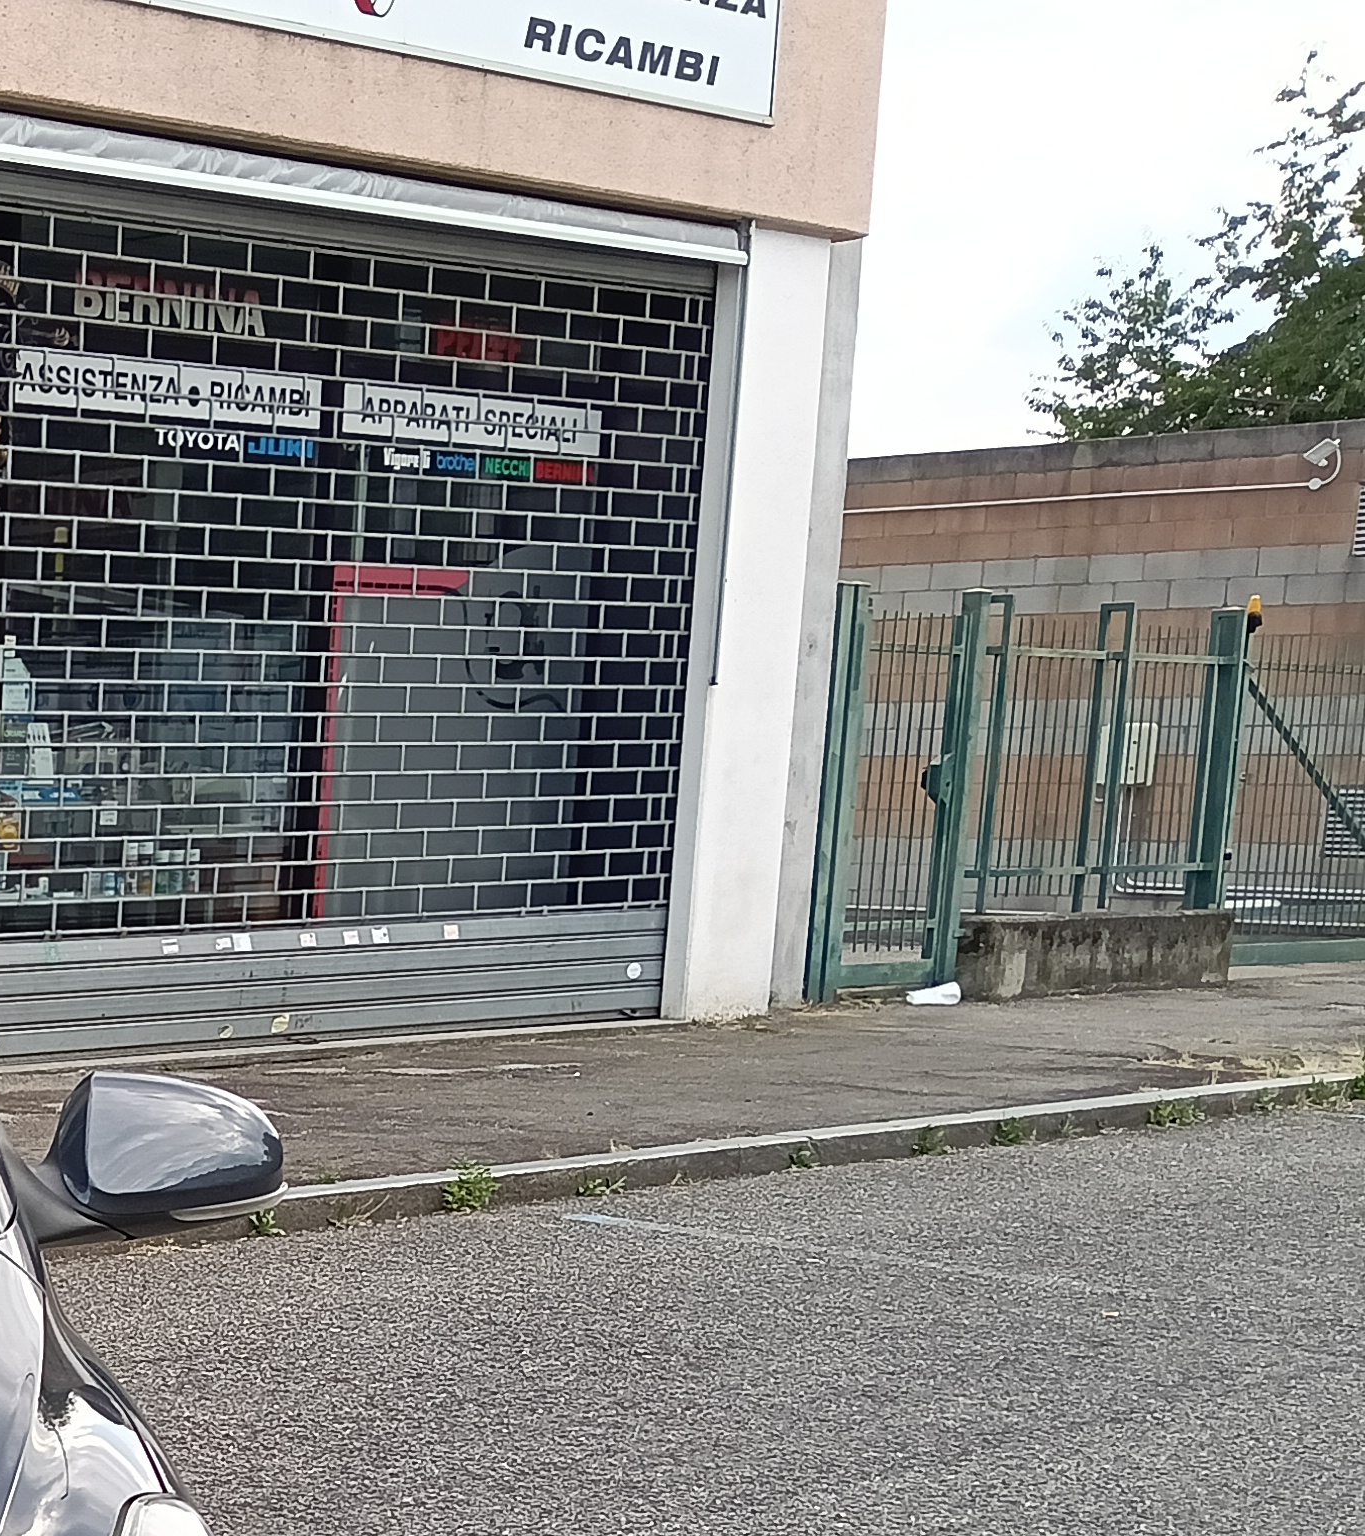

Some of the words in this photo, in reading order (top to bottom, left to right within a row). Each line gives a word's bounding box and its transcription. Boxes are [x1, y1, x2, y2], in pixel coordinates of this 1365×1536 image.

[524, 16, 720, 86] RICAMBI
[73, 268, 266, 337] BERNINA
[19, 361, 181, 405] ASSISTENZA
[210, 380, 311, 418] RICAMBI
[360, 396, 471, 434] APPARATI
[483, 408, 578, 444] SPECIALI
[154, 428, 240, 452] TOYOTA
[247, 436, 314, 459] JUKI
[436, 451, 479, 472] brothe
[484, 456, 531, 477] NECCHI
